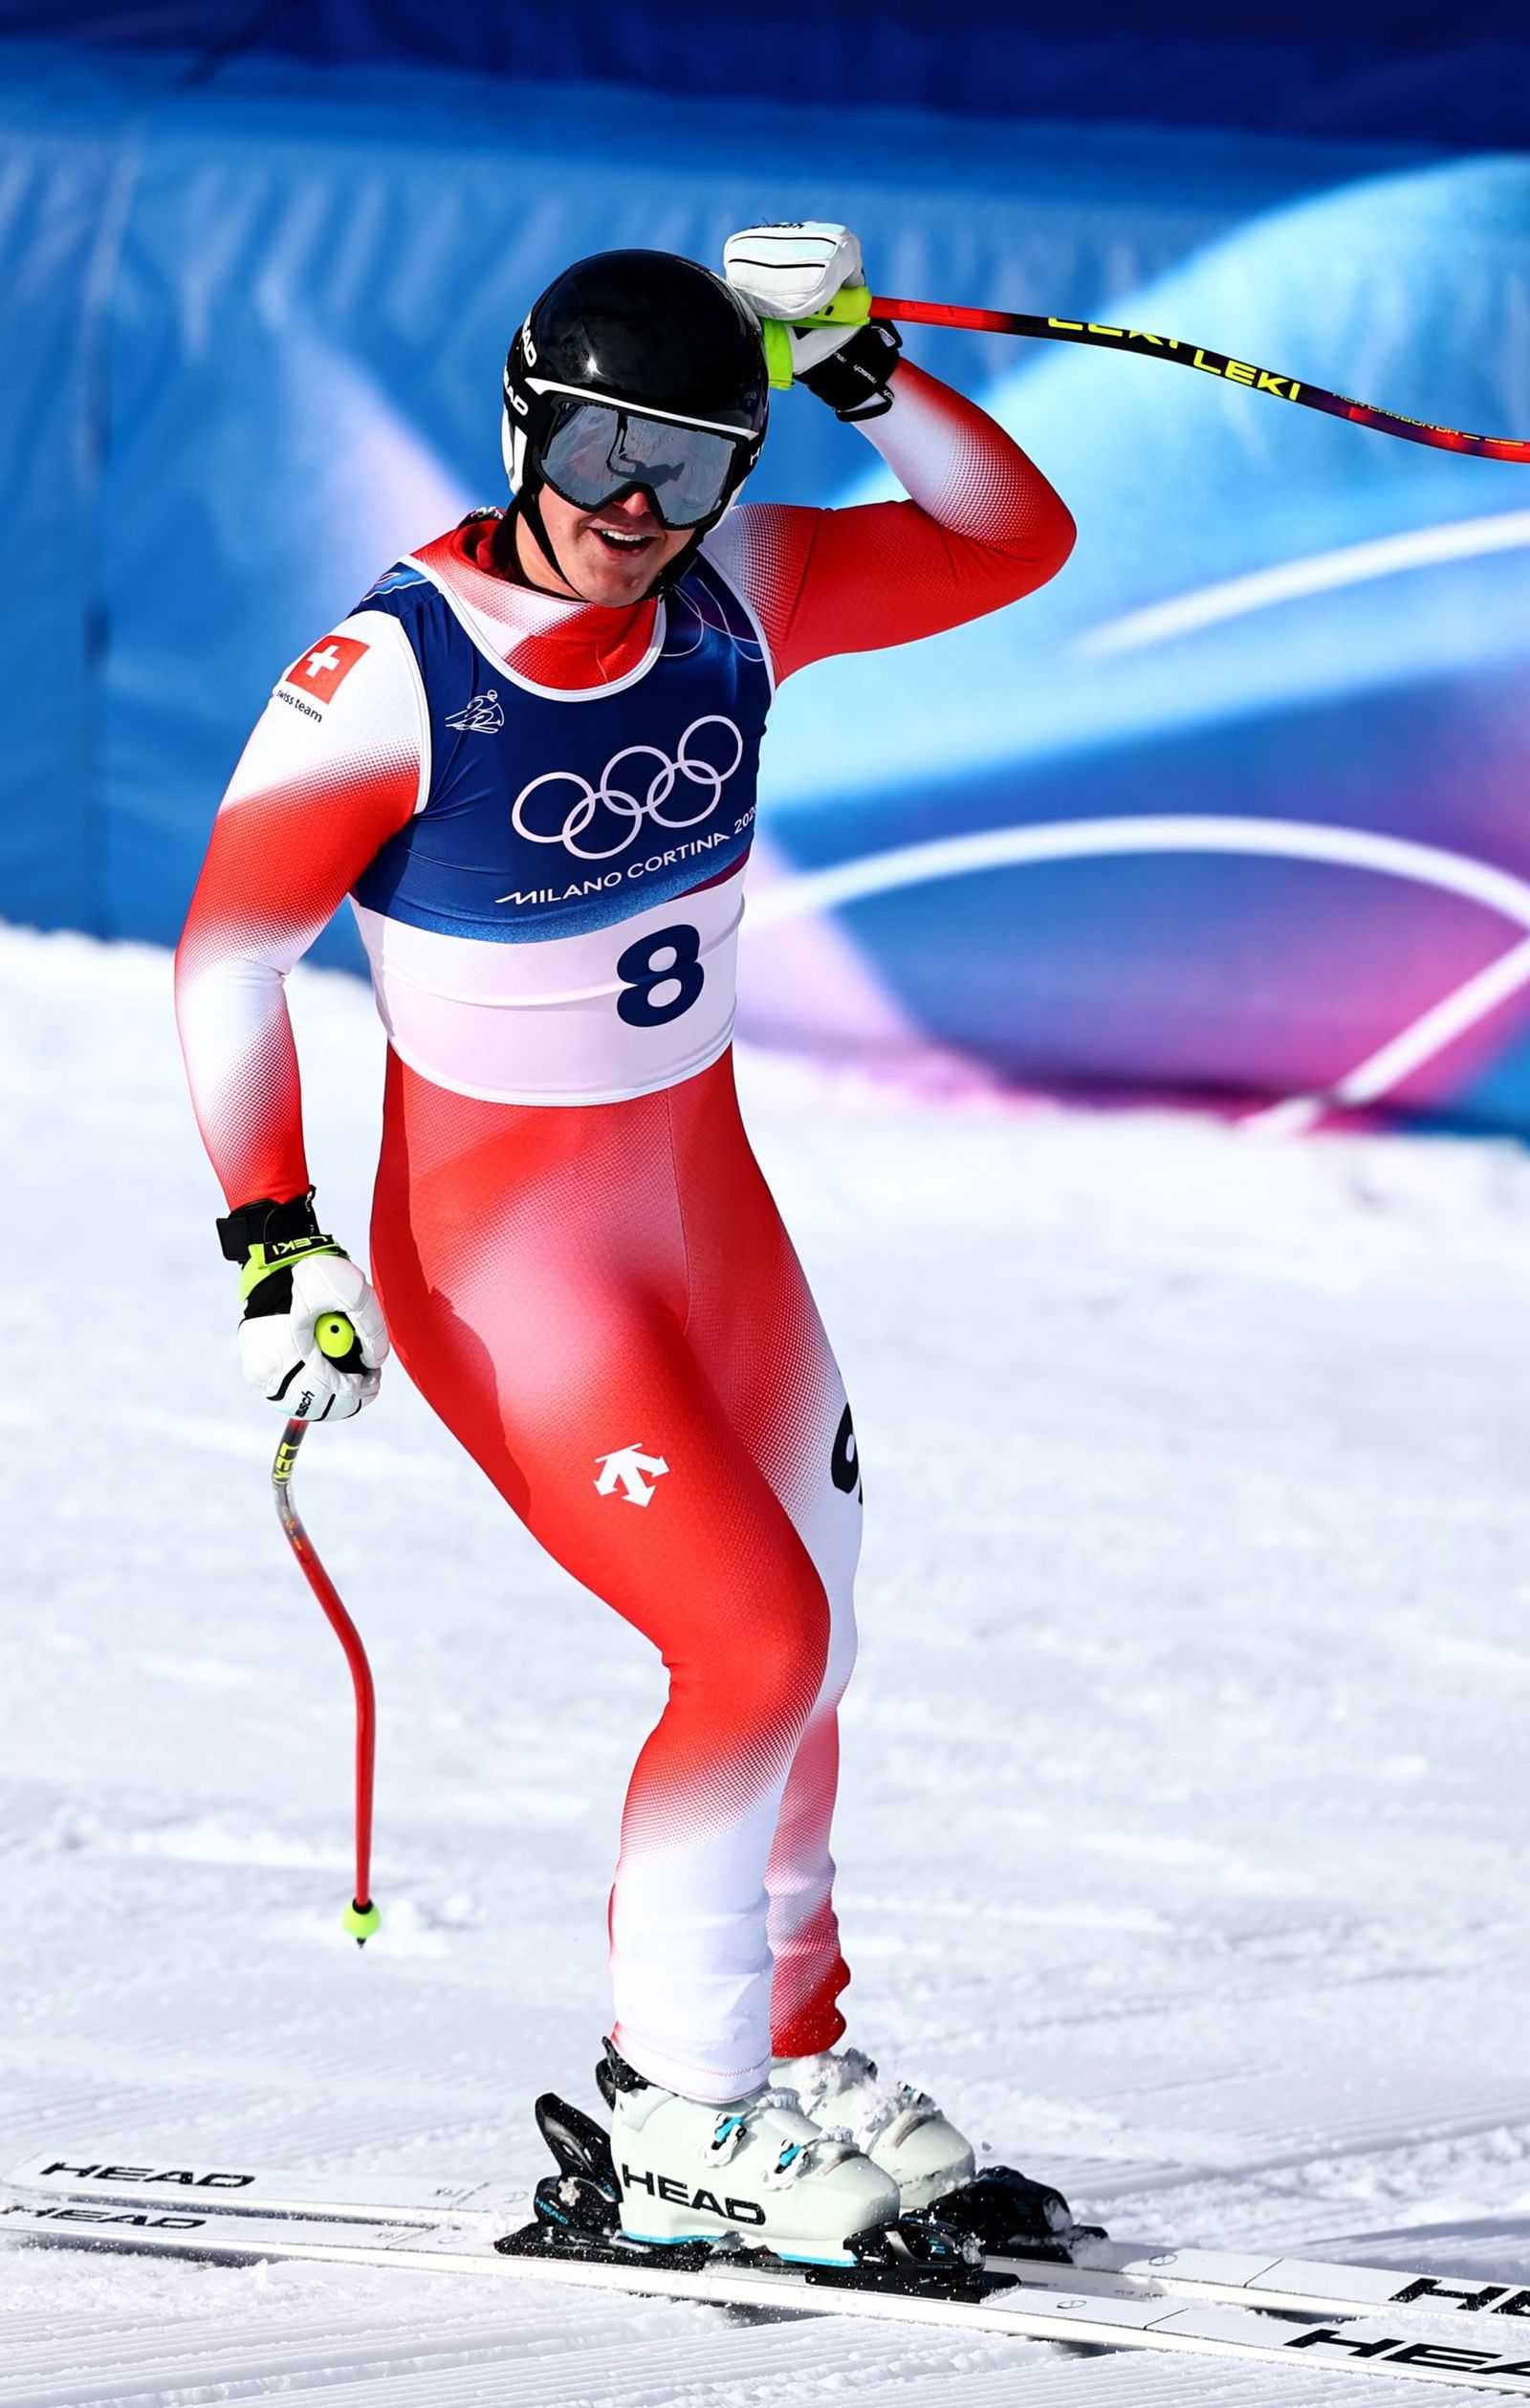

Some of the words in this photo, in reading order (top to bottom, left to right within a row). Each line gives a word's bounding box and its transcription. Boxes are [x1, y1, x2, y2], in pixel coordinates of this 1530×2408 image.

[1193, 349, 1300, 402] LEKI
[295, 698, 323, 723] team
[494, 872, 623, 905] MILANO
[626, 832, 732, 879] CORTINA
[733, 804, 757, 835] 202
[616, 924, 705, 1028] 8
[272, 1236, 329, 1256] LEKI
[39, 2161, 256, 2188] HEAD
[622, 2162, 766, 2226] HEAD
[0, 2204, 207, 2229] HEAD
